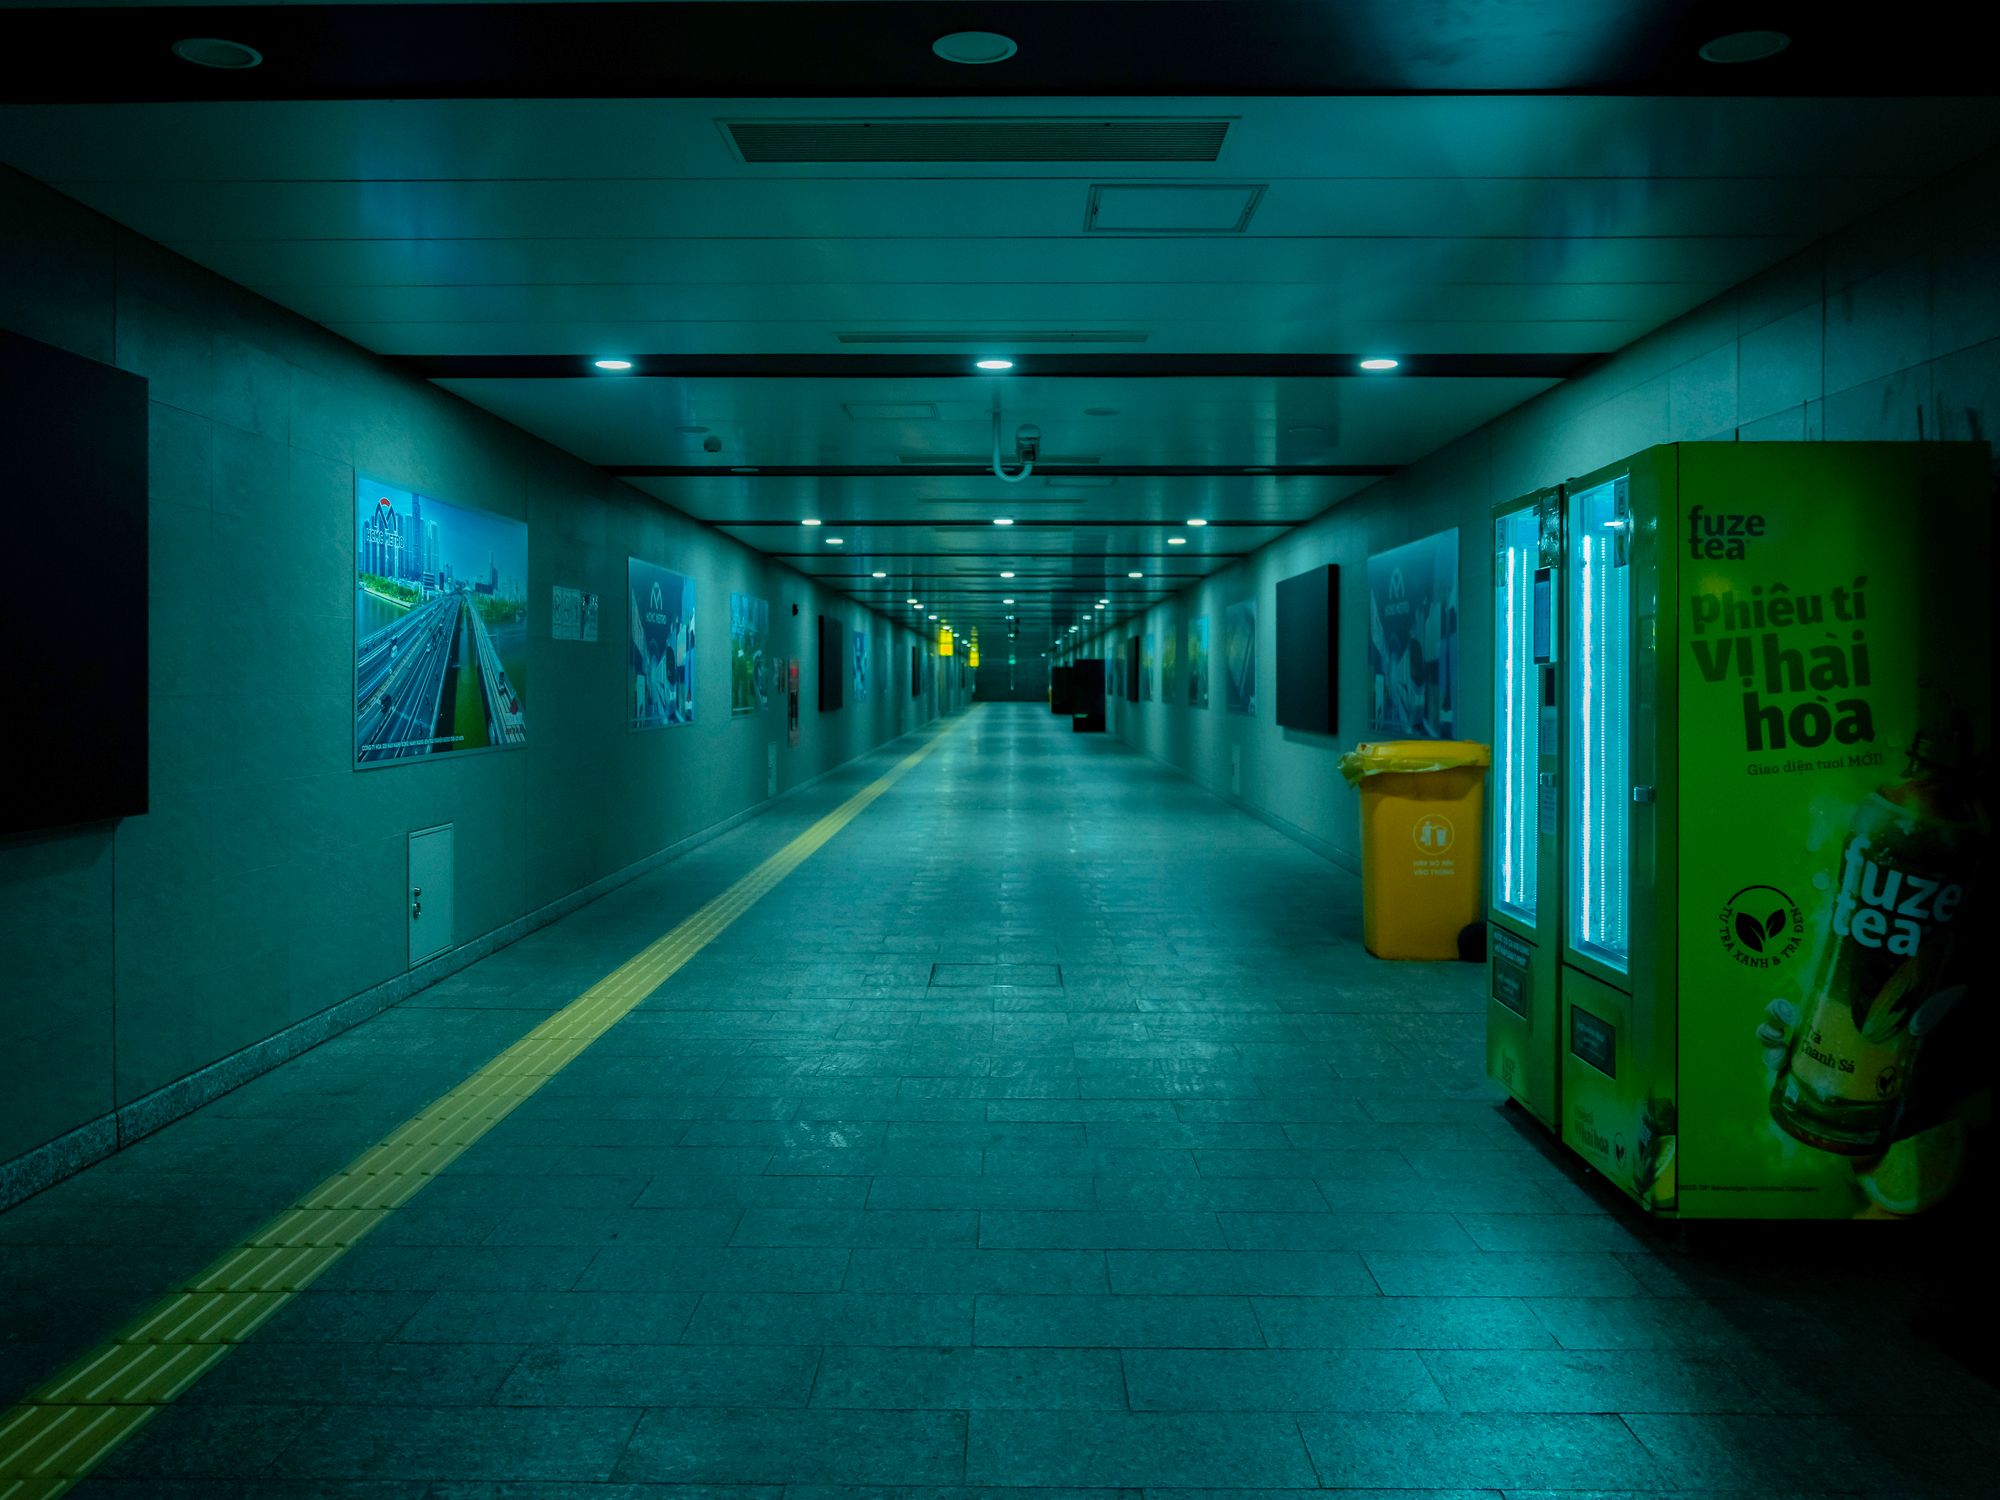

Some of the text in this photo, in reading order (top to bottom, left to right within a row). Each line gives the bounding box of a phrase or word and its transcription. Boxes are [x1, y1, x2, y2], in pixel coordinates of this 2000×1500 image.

[1688, 504, 1766, 537] fuze
[1688, 535, 1745, 560] tea
[1690, 575, 1868, 636] phiêu tí
[1690, 630, 1871, 695] vị hài
[1743, 691, 1876, 752] hòa
[1747, 763, 1780, 776] Giao
[1783, 759, 1813, 776] diện
[1841, 836, 1965, 923] fuze
[1832, 893, 1922, 959] tea
[1733, 950, 1769, 969] XANH
[1771, 956, 1781, 967] &
